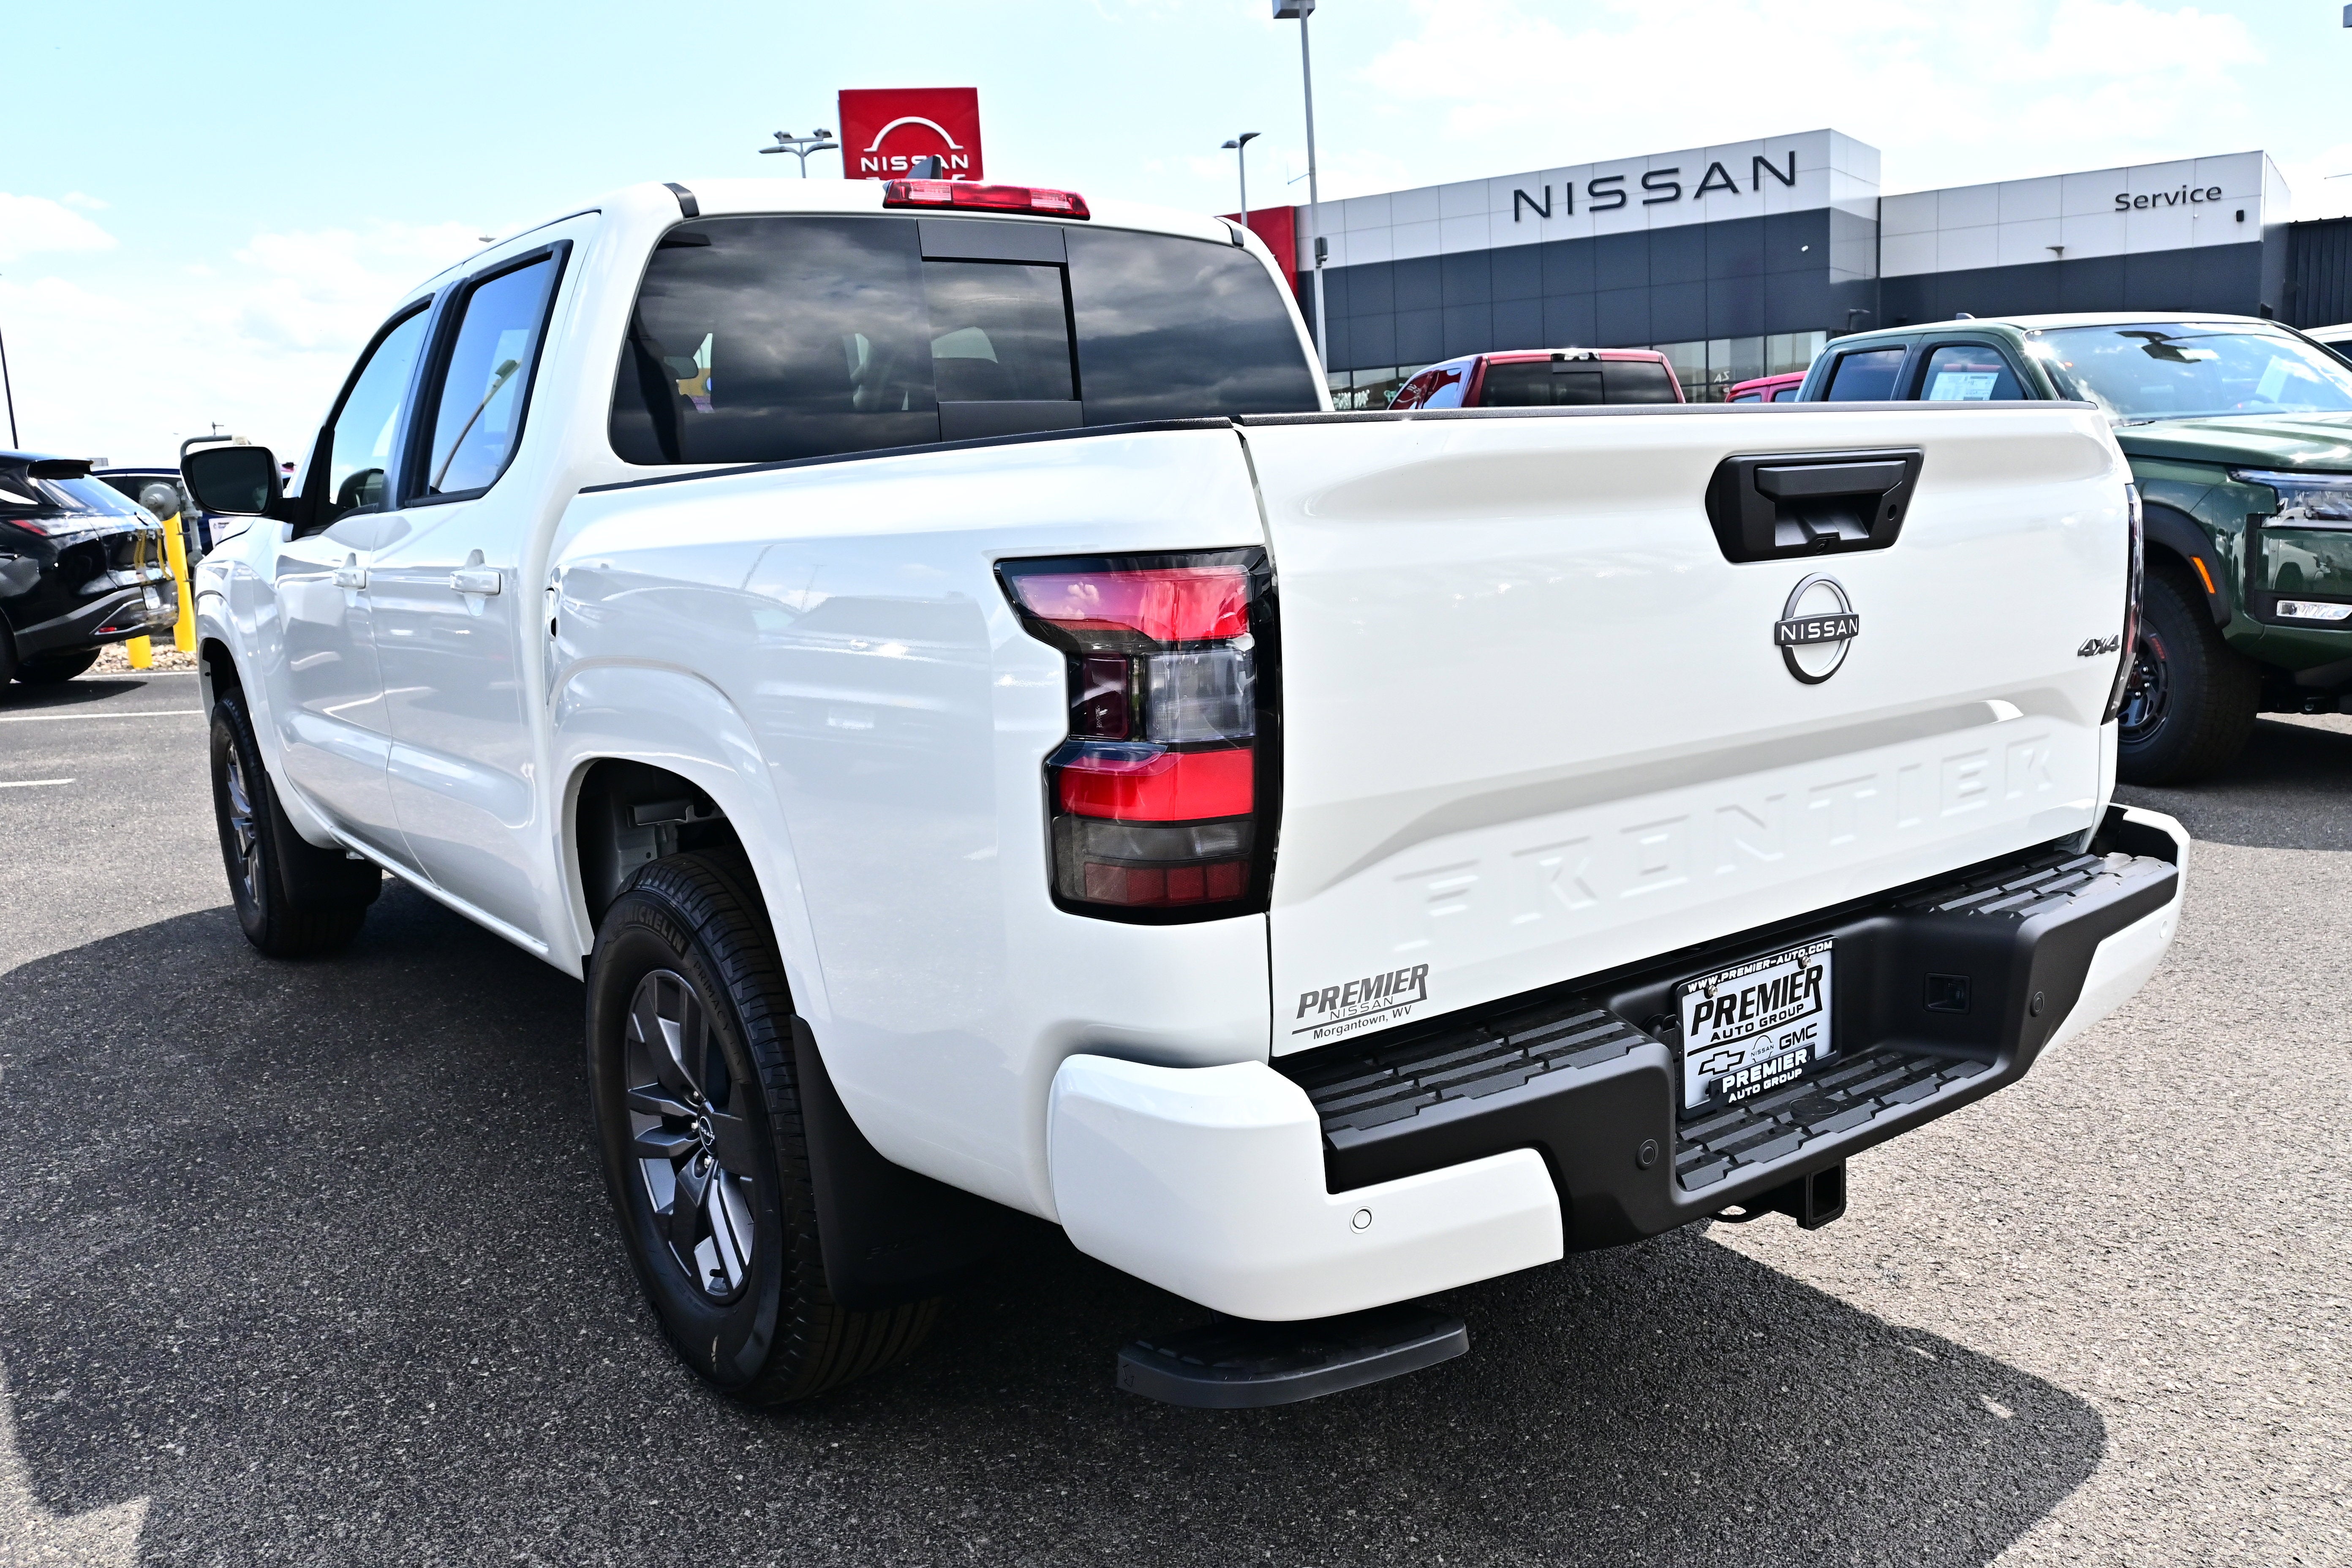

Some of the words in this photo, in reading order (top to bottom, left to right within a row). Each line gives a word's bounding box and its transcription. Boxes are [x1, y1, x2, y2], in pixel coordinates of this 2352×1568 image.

[1514, 151, 1796, 222] NISSAN
[2115, 185, 2221, 211] Service
[1781, 618, 1858, 641] NISSAN
[1390, 732, 2054, 950] FRONTIER
[625, 905, 686, 953] MICHELIN
[1687, 940, 1833, 993] WWW.PREMIER-AUTO.COM
[693, 961, 732, 1032] PRIMACY
[1296, 964, 1429, 1019] PREMIER
[1330, 996, 1394, 1021] NISSAN
[1690, 964, 1823, 1037] PREMIER
[1314, 1014, 1388, 1040] Morgantown,
[1393, 1005, 1412, 1018] WV
[1710, 1023, 1754, 1042] AUTO
[1759, 1003, 1804, 1027] GROUP
[1779, 1023, 1817, 1051] GMC
[1723, 1048, 1808, 1093] PREMIER
[1751, 1045, 1774, 1057] NISSAN
[1729, 1085, 1760, 1103] AUTO
[1764, 1068, 1802, 1090] GROUP
